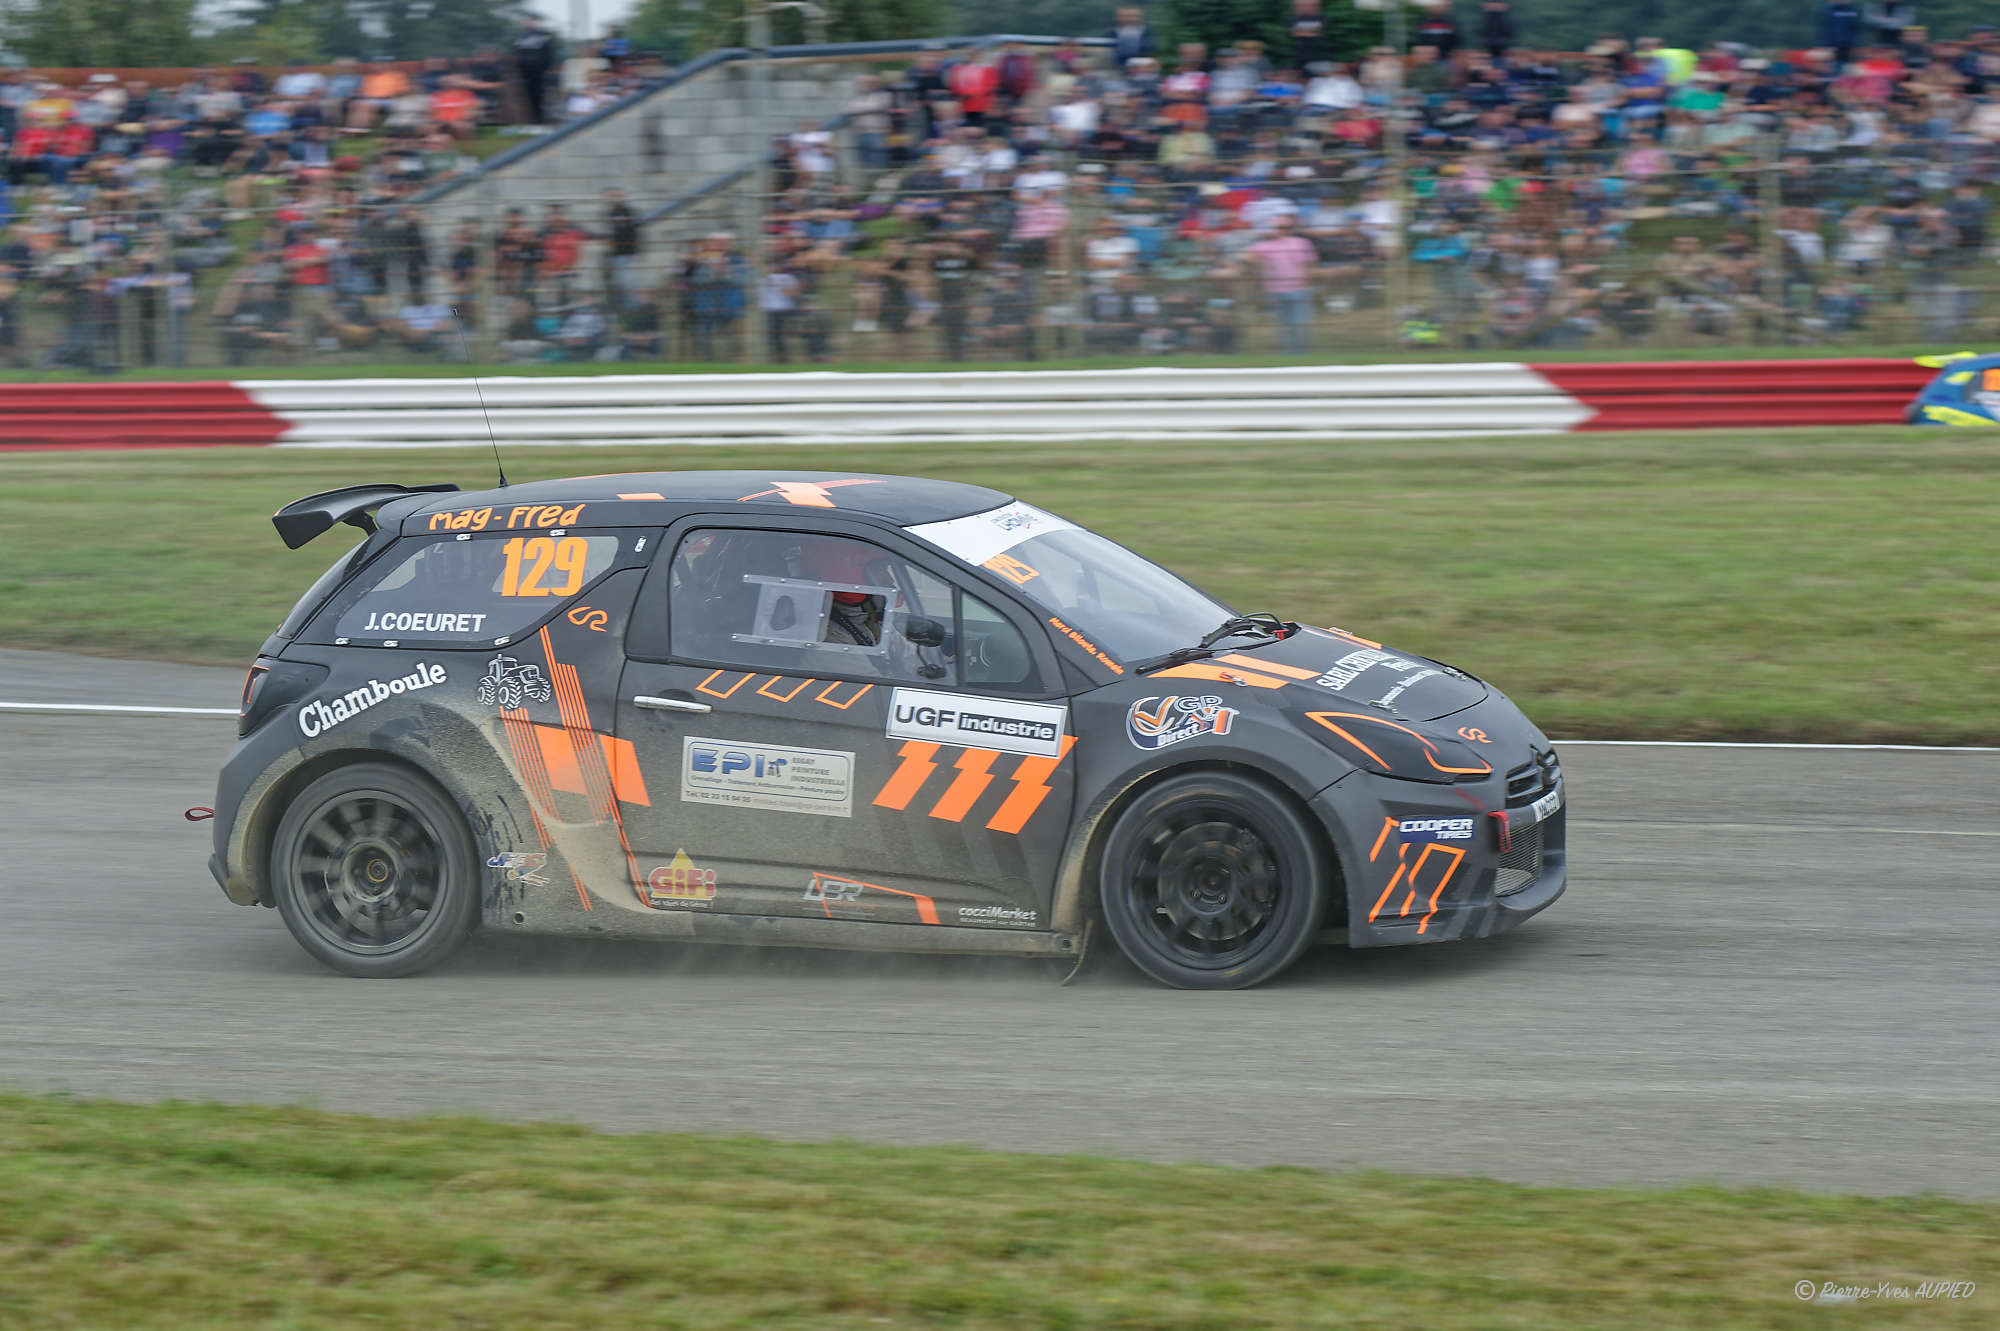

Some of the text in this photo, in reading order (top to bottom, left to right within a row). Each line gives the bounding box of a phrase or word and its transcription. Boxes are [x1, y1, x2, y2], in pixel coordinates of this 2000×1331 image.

[502, 536, 589, 597] 129
[364, 612, 486, 633] J.COEURET
[298, 661, 447, 738] Chamboule
[895, 704, 1055, 739] UGF industrie
[1157, 721, 1200, 748] Direct
[692, 748, 766, 778] EPI
[1400, 819, 1474, 833] COOPER
[1435, 830, 1473, 840] TIRES
[959, 906, 1037, 921] cocciMarket
